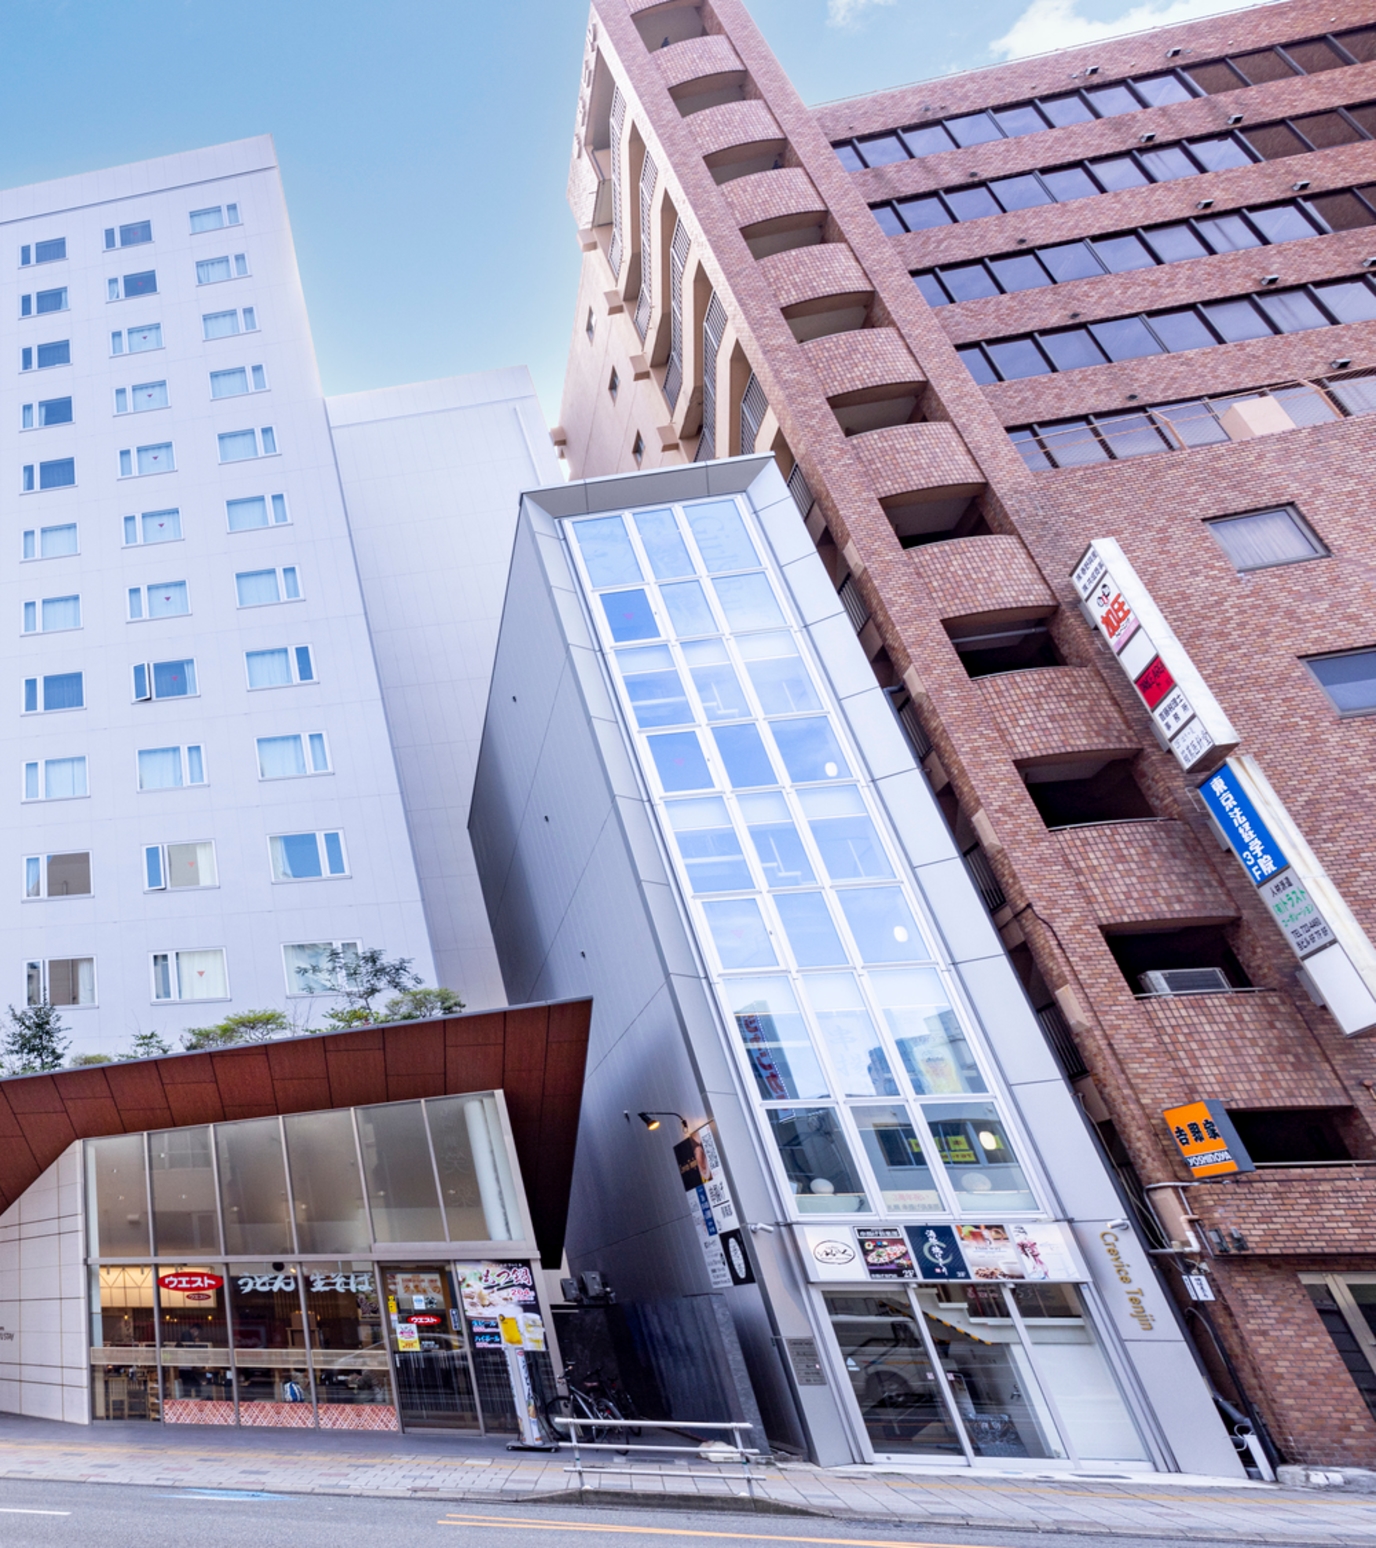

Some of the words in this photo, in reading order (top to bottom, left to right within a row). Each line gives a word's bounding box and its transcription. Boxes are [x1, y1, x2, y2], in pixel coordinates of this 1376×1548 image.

[1100, 593, 1131, 638] 加圧
[1209, 775, 1277, 876] 東京法経学院
[1242, 851, 1262, 881] 3F
[1174, 1118, 1221, 1146] 吉野家
[1186, 1151, 1232, 1166] YOSHINOYA
[164, 1275, 216, 1288] ウエスト
[237, 1272, 296, 1294] うどん
[1099, 1231, 1132, 1284] Crevice
[1125, 1287, 1156, 1331] Tenjin
